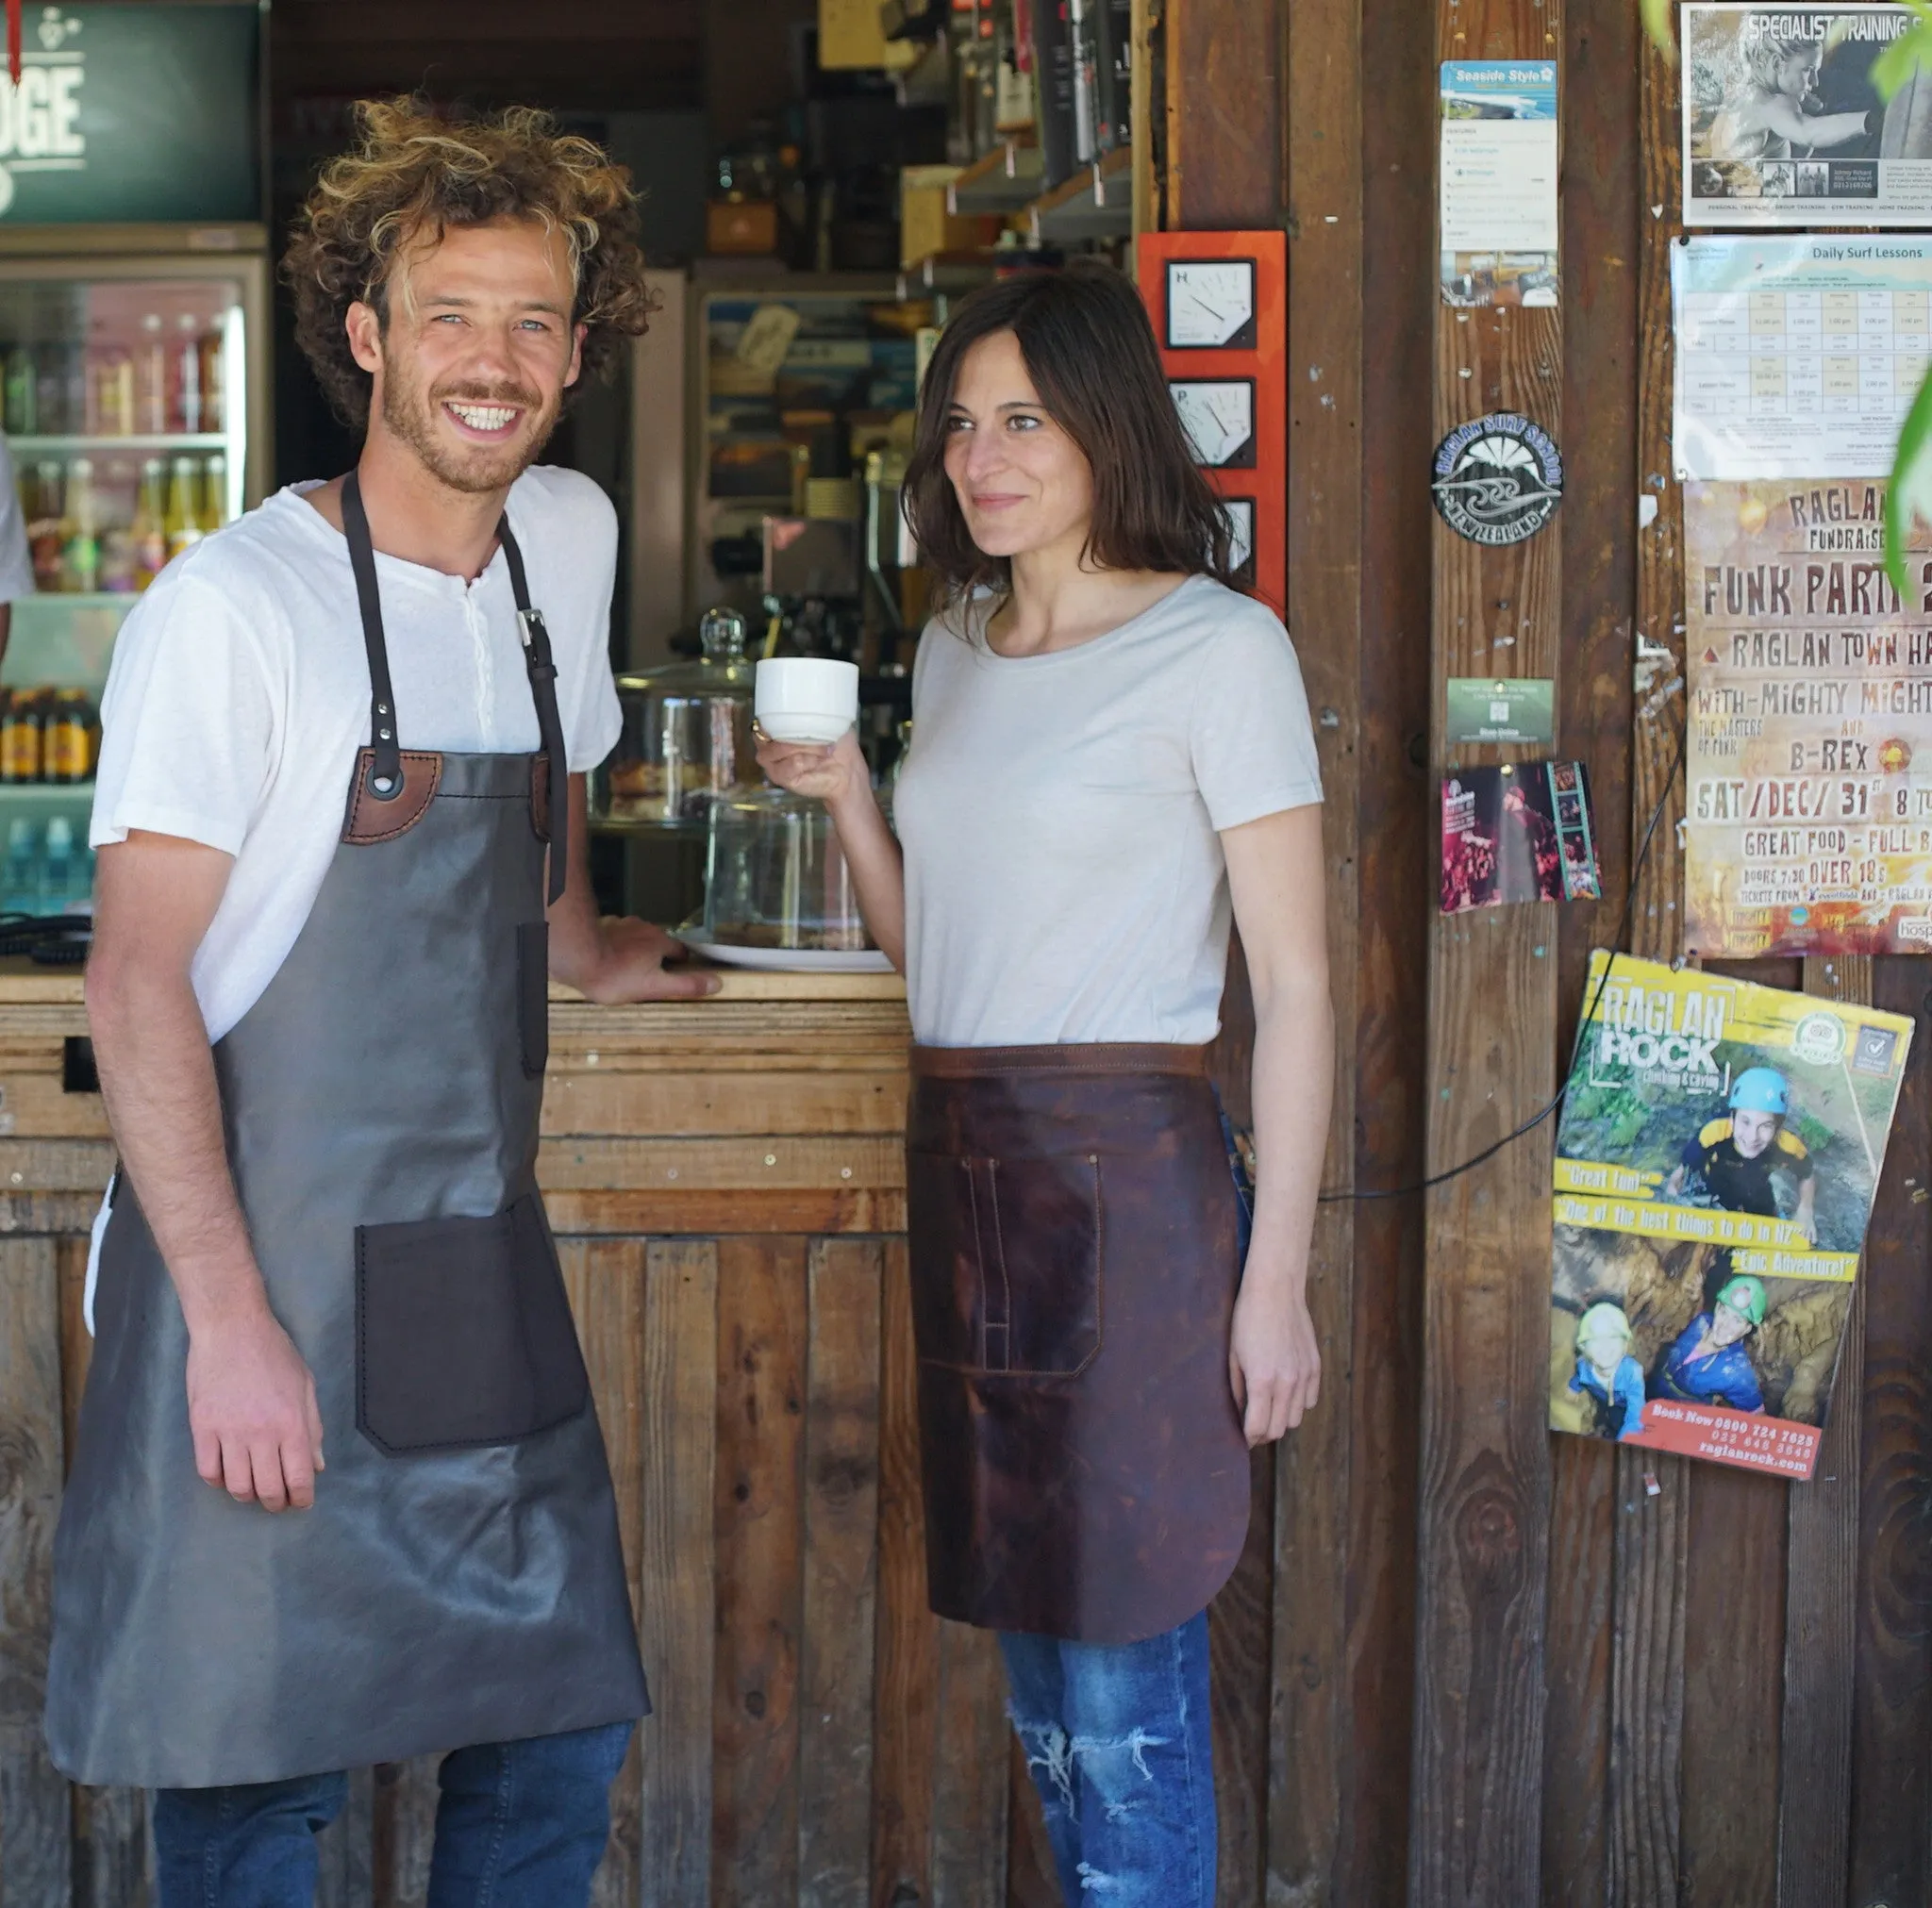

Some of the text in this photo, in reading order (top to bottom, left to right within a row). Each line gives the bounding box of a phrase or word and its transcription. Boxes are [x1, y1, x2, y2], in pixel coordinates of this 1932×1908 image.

[1748, 15, 1834, 41] SPECIALIST
[1838, 15, 1907, 41] TRAINING
[1456, 70, 1541, 83] Seaside Style
[1812, 247, 1923, 261] Daily Surf Lessons
[1176, 272, 1188, 283] H
[1436, 423, 1483, 474] RAGLAN
[1484, 413, 1528, 437] SURF
[1474, 510, 1543, 545] ZEALAND
[1704, 566, 1791, 615] FUNK
[1732, 632, 1831, 668] RAGLAN
[1840, 633, 1898, 666] TOWN
[1720, 718, 1762, 738] MASTERS
[1790, 739, 1869, 771] B-REX
[1897, 788, 1907, 816] 8
[1745, 830, 1800, 857] GREAT
[1808, 829, 1846, 854] FOOD
[1869, 828, 1913, 853] FULL
[1744, 868, 1776, 884] DOORS
[1809, 859, 1852, 884] OVER
[1741, 889, 1773, 904] TICKETS
[1604, 986, 1725, 1041] RAGLAN
[1601, 1030, 1721, 1076] ROCK
[1594, 1203, 1607, 1222] of
[1614, 1203, 1634, 1225] the
[1641, 1209, 1669, 1231] best
[1675, 1213, 1714, 1236] things
[1721, 1218, 1734, 1236] to
[1740, 1219, 1754, 1239] do
[1757, 1222, 1771, 1241] in
[1652, 1403, 1814, 1447] Book Now 0800 724 7625
[1711, 1430, 1738, 1445] 022
[1699, 1441, 1807, 1472] raglanrock.com
